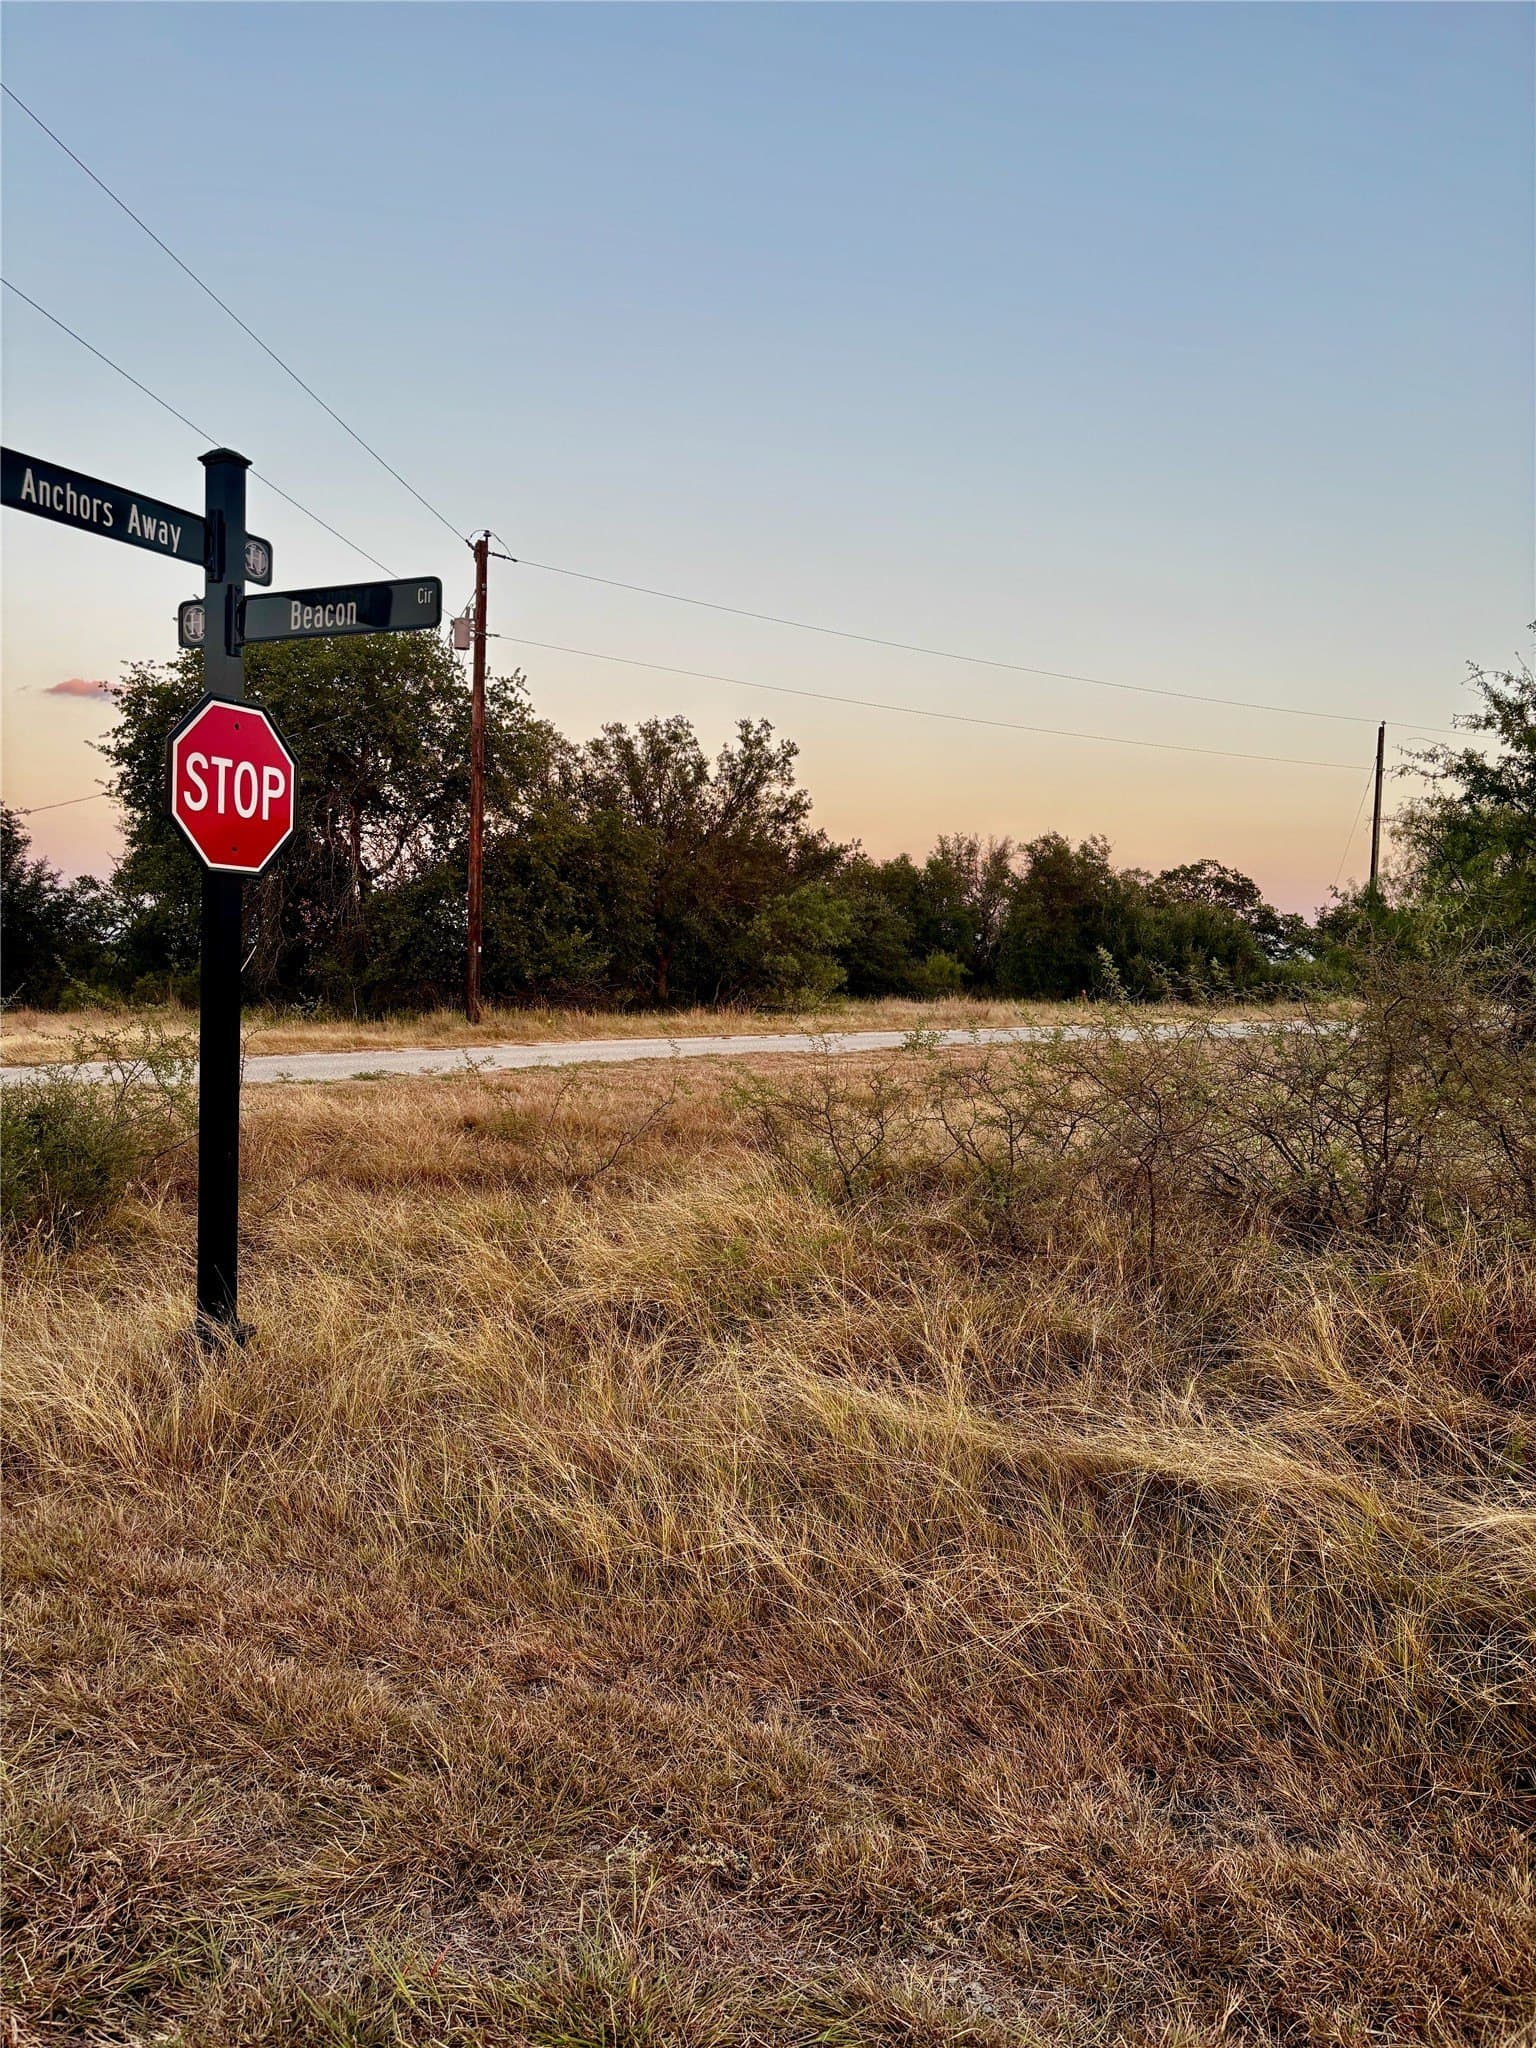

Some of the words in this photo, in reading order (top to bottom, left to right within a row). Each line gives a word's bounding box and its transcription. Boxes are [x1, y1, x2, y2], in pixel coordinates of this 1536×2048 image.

[21, 468, 114, 528] Anchors
[128, 503, 182, 553] Away
[290, 600, 358, 632] Beacon
[417, 587, 433, 605] Cir
[183, 751, 286, 821] STOP
